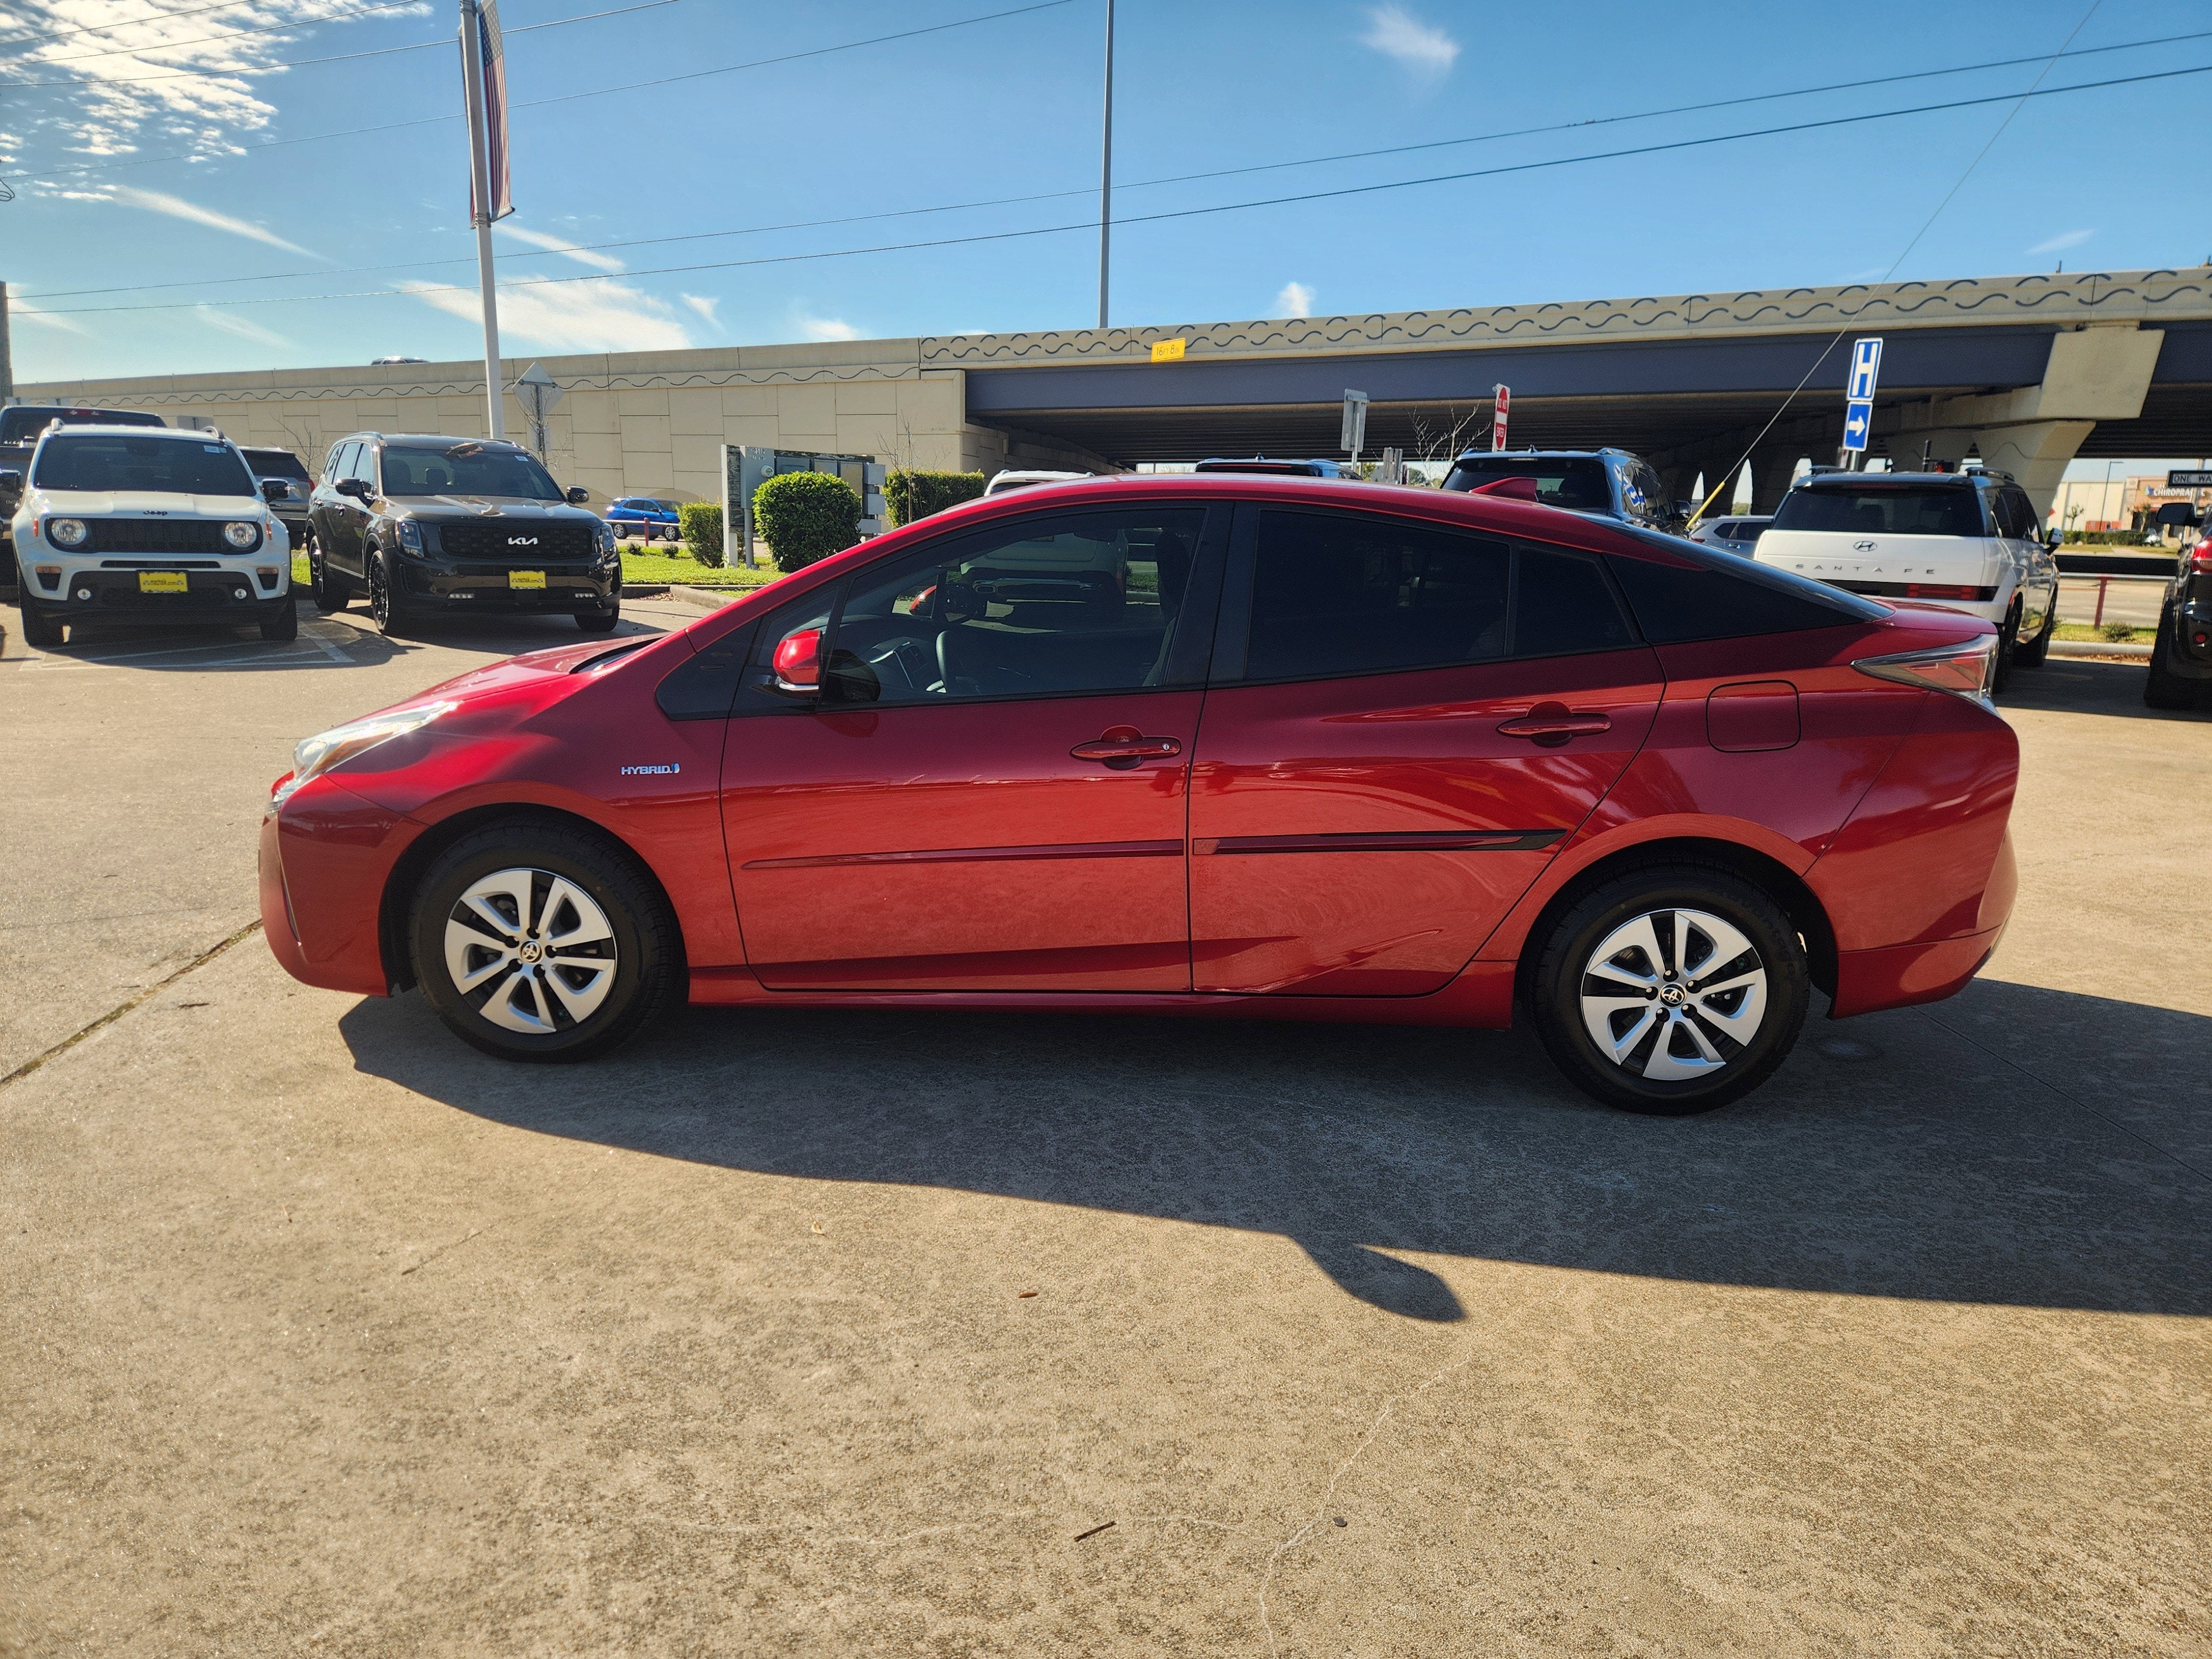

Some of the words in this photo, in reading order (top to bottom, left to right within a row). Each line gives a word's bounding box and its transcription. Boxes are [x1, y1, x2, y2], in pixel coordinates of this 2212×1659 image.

[1853, 343, 1879, 397] H
[1498, 398, 1502, 409] DO
[508, 537, 538, 545] KIA
[1796, 564, 1882, 573] SANTA
[621, 765, 670, 775] HYBRID
